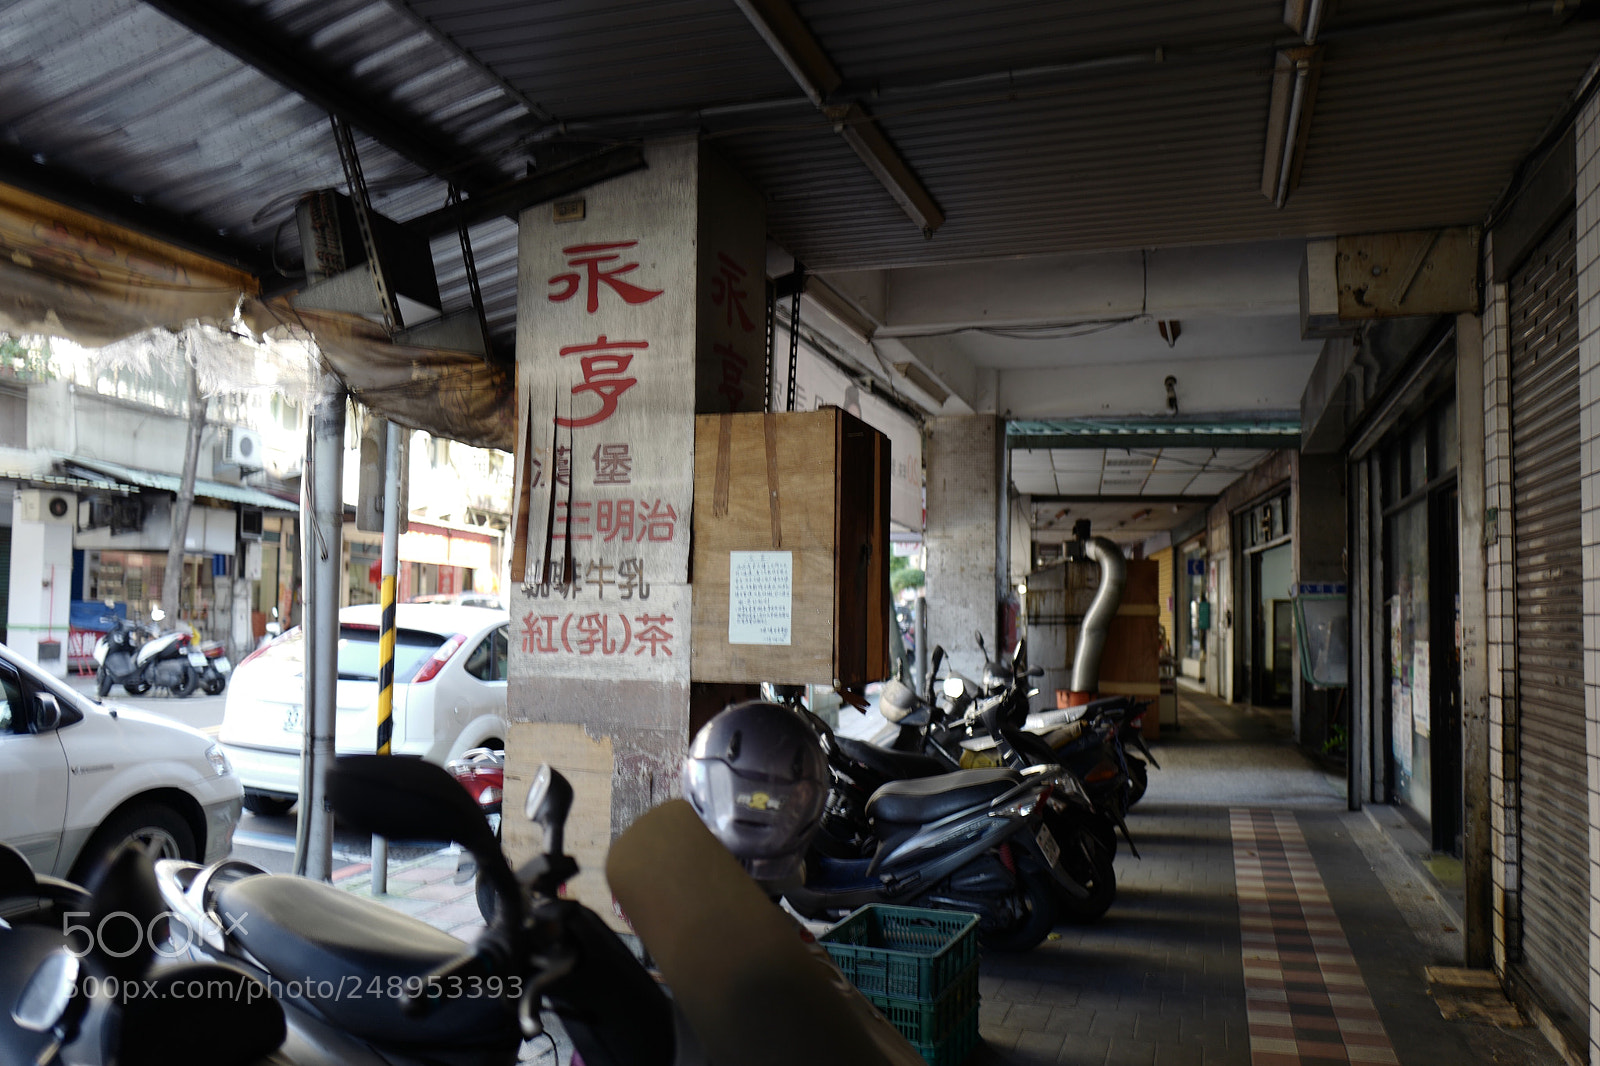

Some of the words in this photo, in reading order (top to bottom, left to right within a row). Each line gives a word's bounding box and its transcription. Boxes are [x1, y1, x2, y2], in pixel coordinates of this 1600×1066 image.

[548, 239, 665, 428] 永亨
[552, 498, 678, 543] 三明治
[521, 611, 674, 657] 紅(乳)茶
